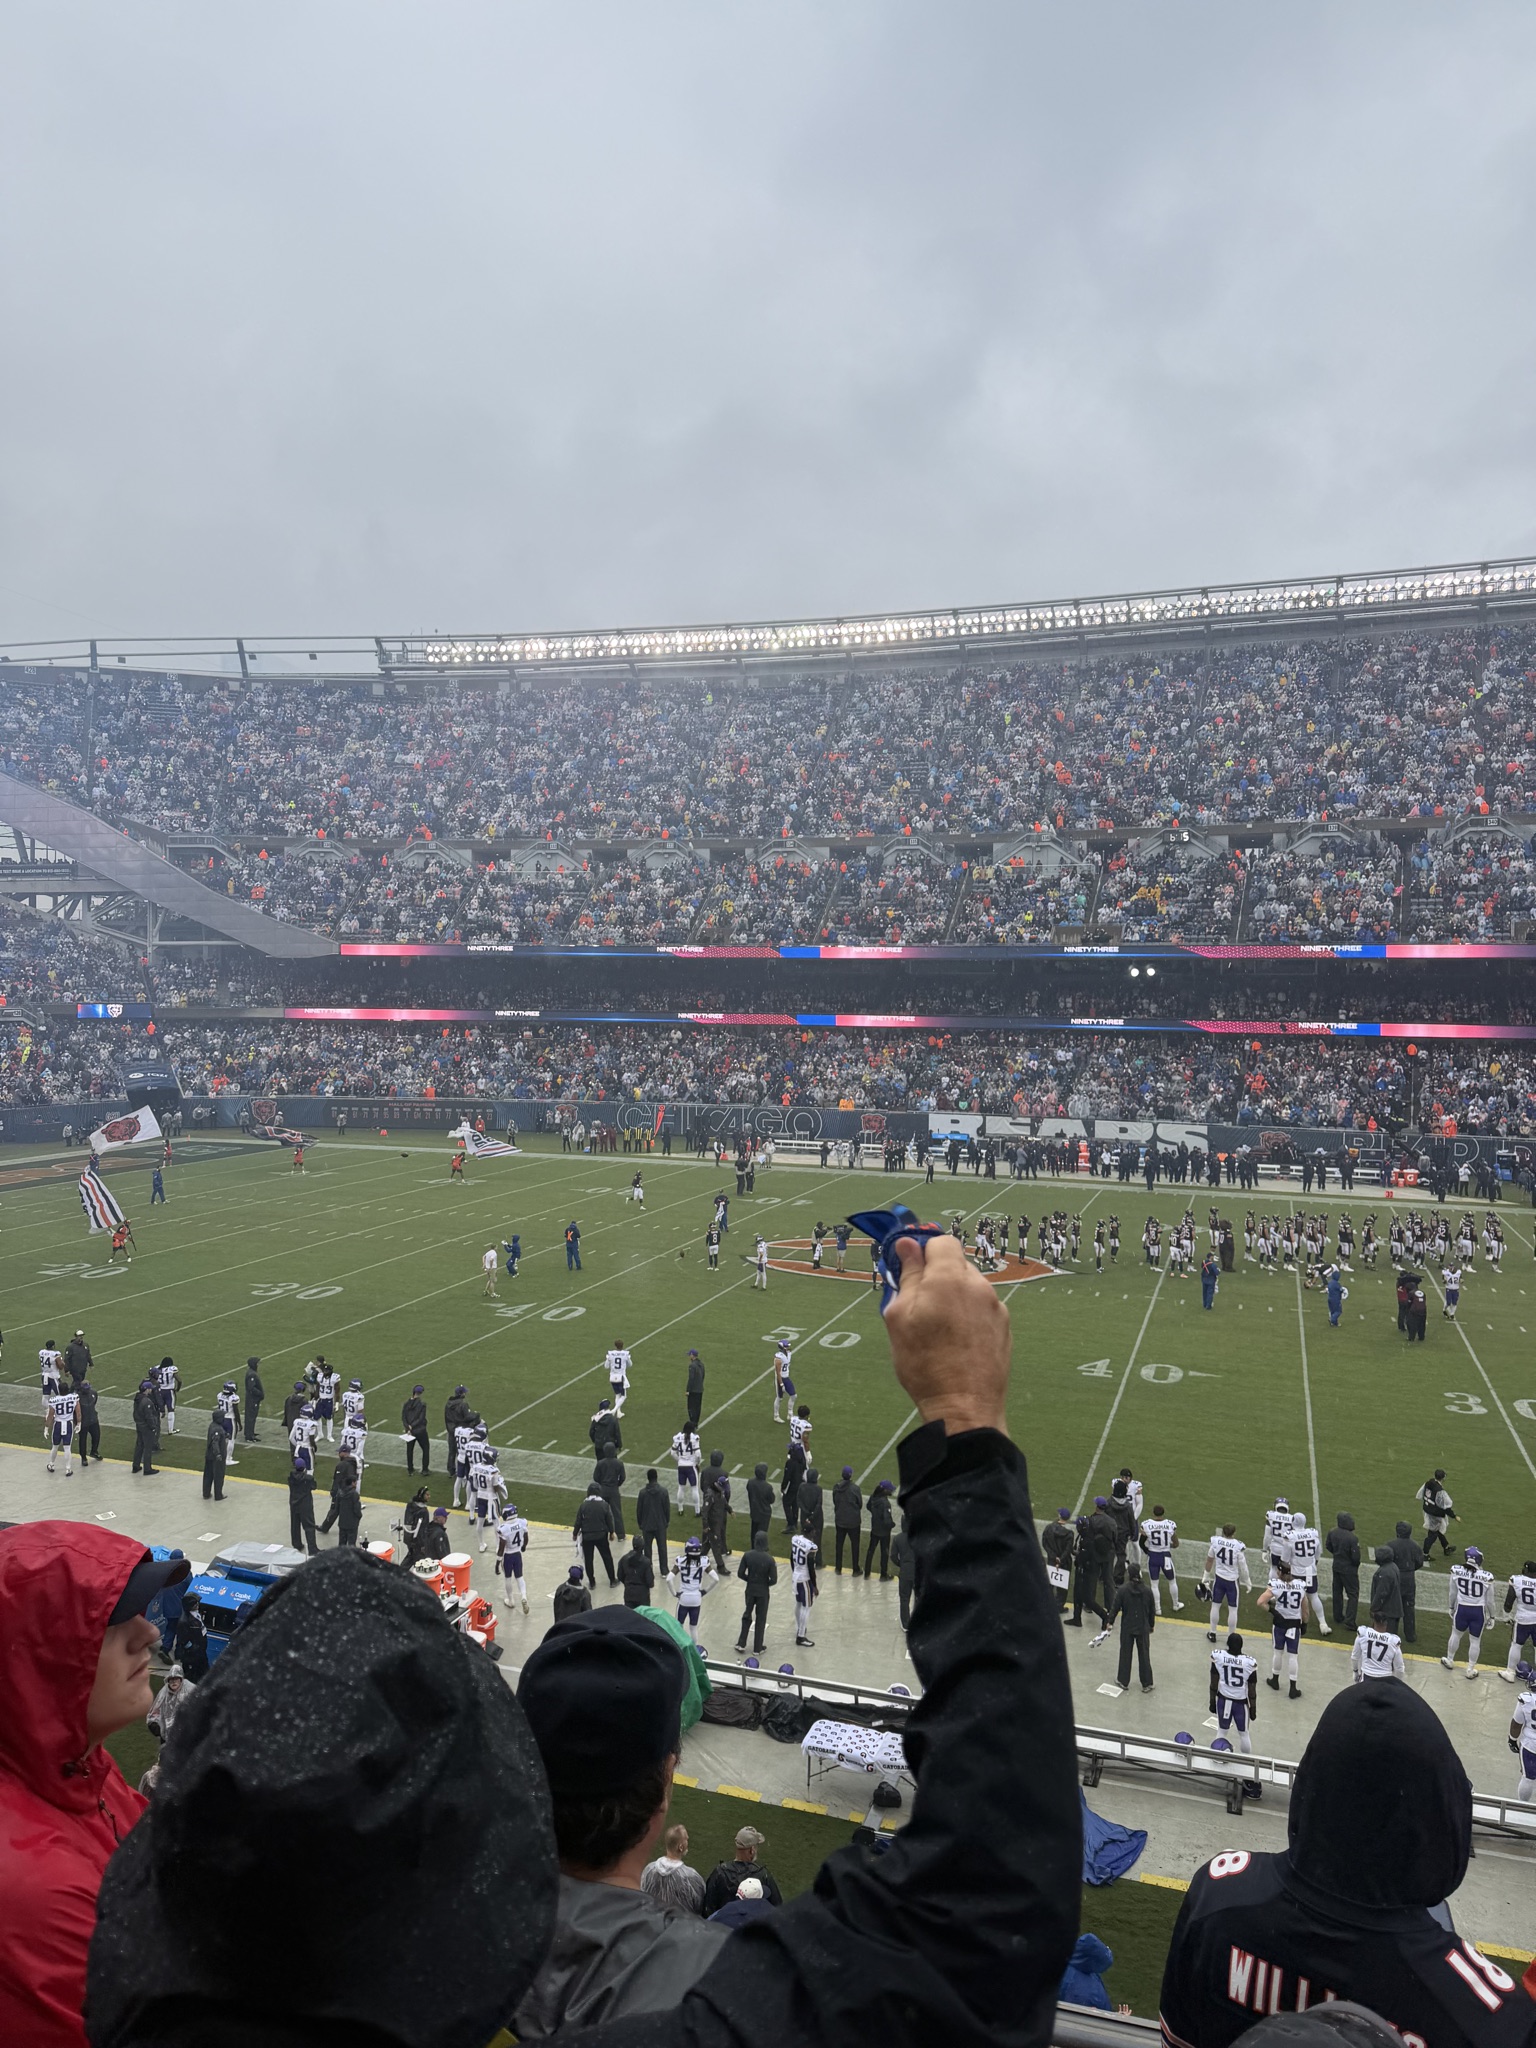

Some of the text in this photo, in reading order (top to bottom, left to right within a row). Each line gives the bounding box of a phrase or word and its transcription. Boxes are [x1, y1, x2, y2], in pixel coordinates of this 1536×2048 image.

[614, 1357, 622, 1370] 9
[55, 1401, 75, 1416] 86
[676, 1441, 694, 1456] 44
[512, 1531, 522, 1547] 4
[1151, 1531, 1169, 1546] 51
[1216, 1547, 1234, 1566] 41
[1294, 1539, 1317, 1558] 95
[445, 1571, 455, 1585] G
[680, 1565, 702, 1584] 24
[1456, 1577, 1484, 1598] 90
[1277, 1591, 1302, 1610] 43
[1366, 1639, 1389, 1662] 17
[1223, 1656, 1243, 1666] TURNER
[1222, 1664, 1244, 1688] 15
[1445, 1938, 1517, 2013] 18
